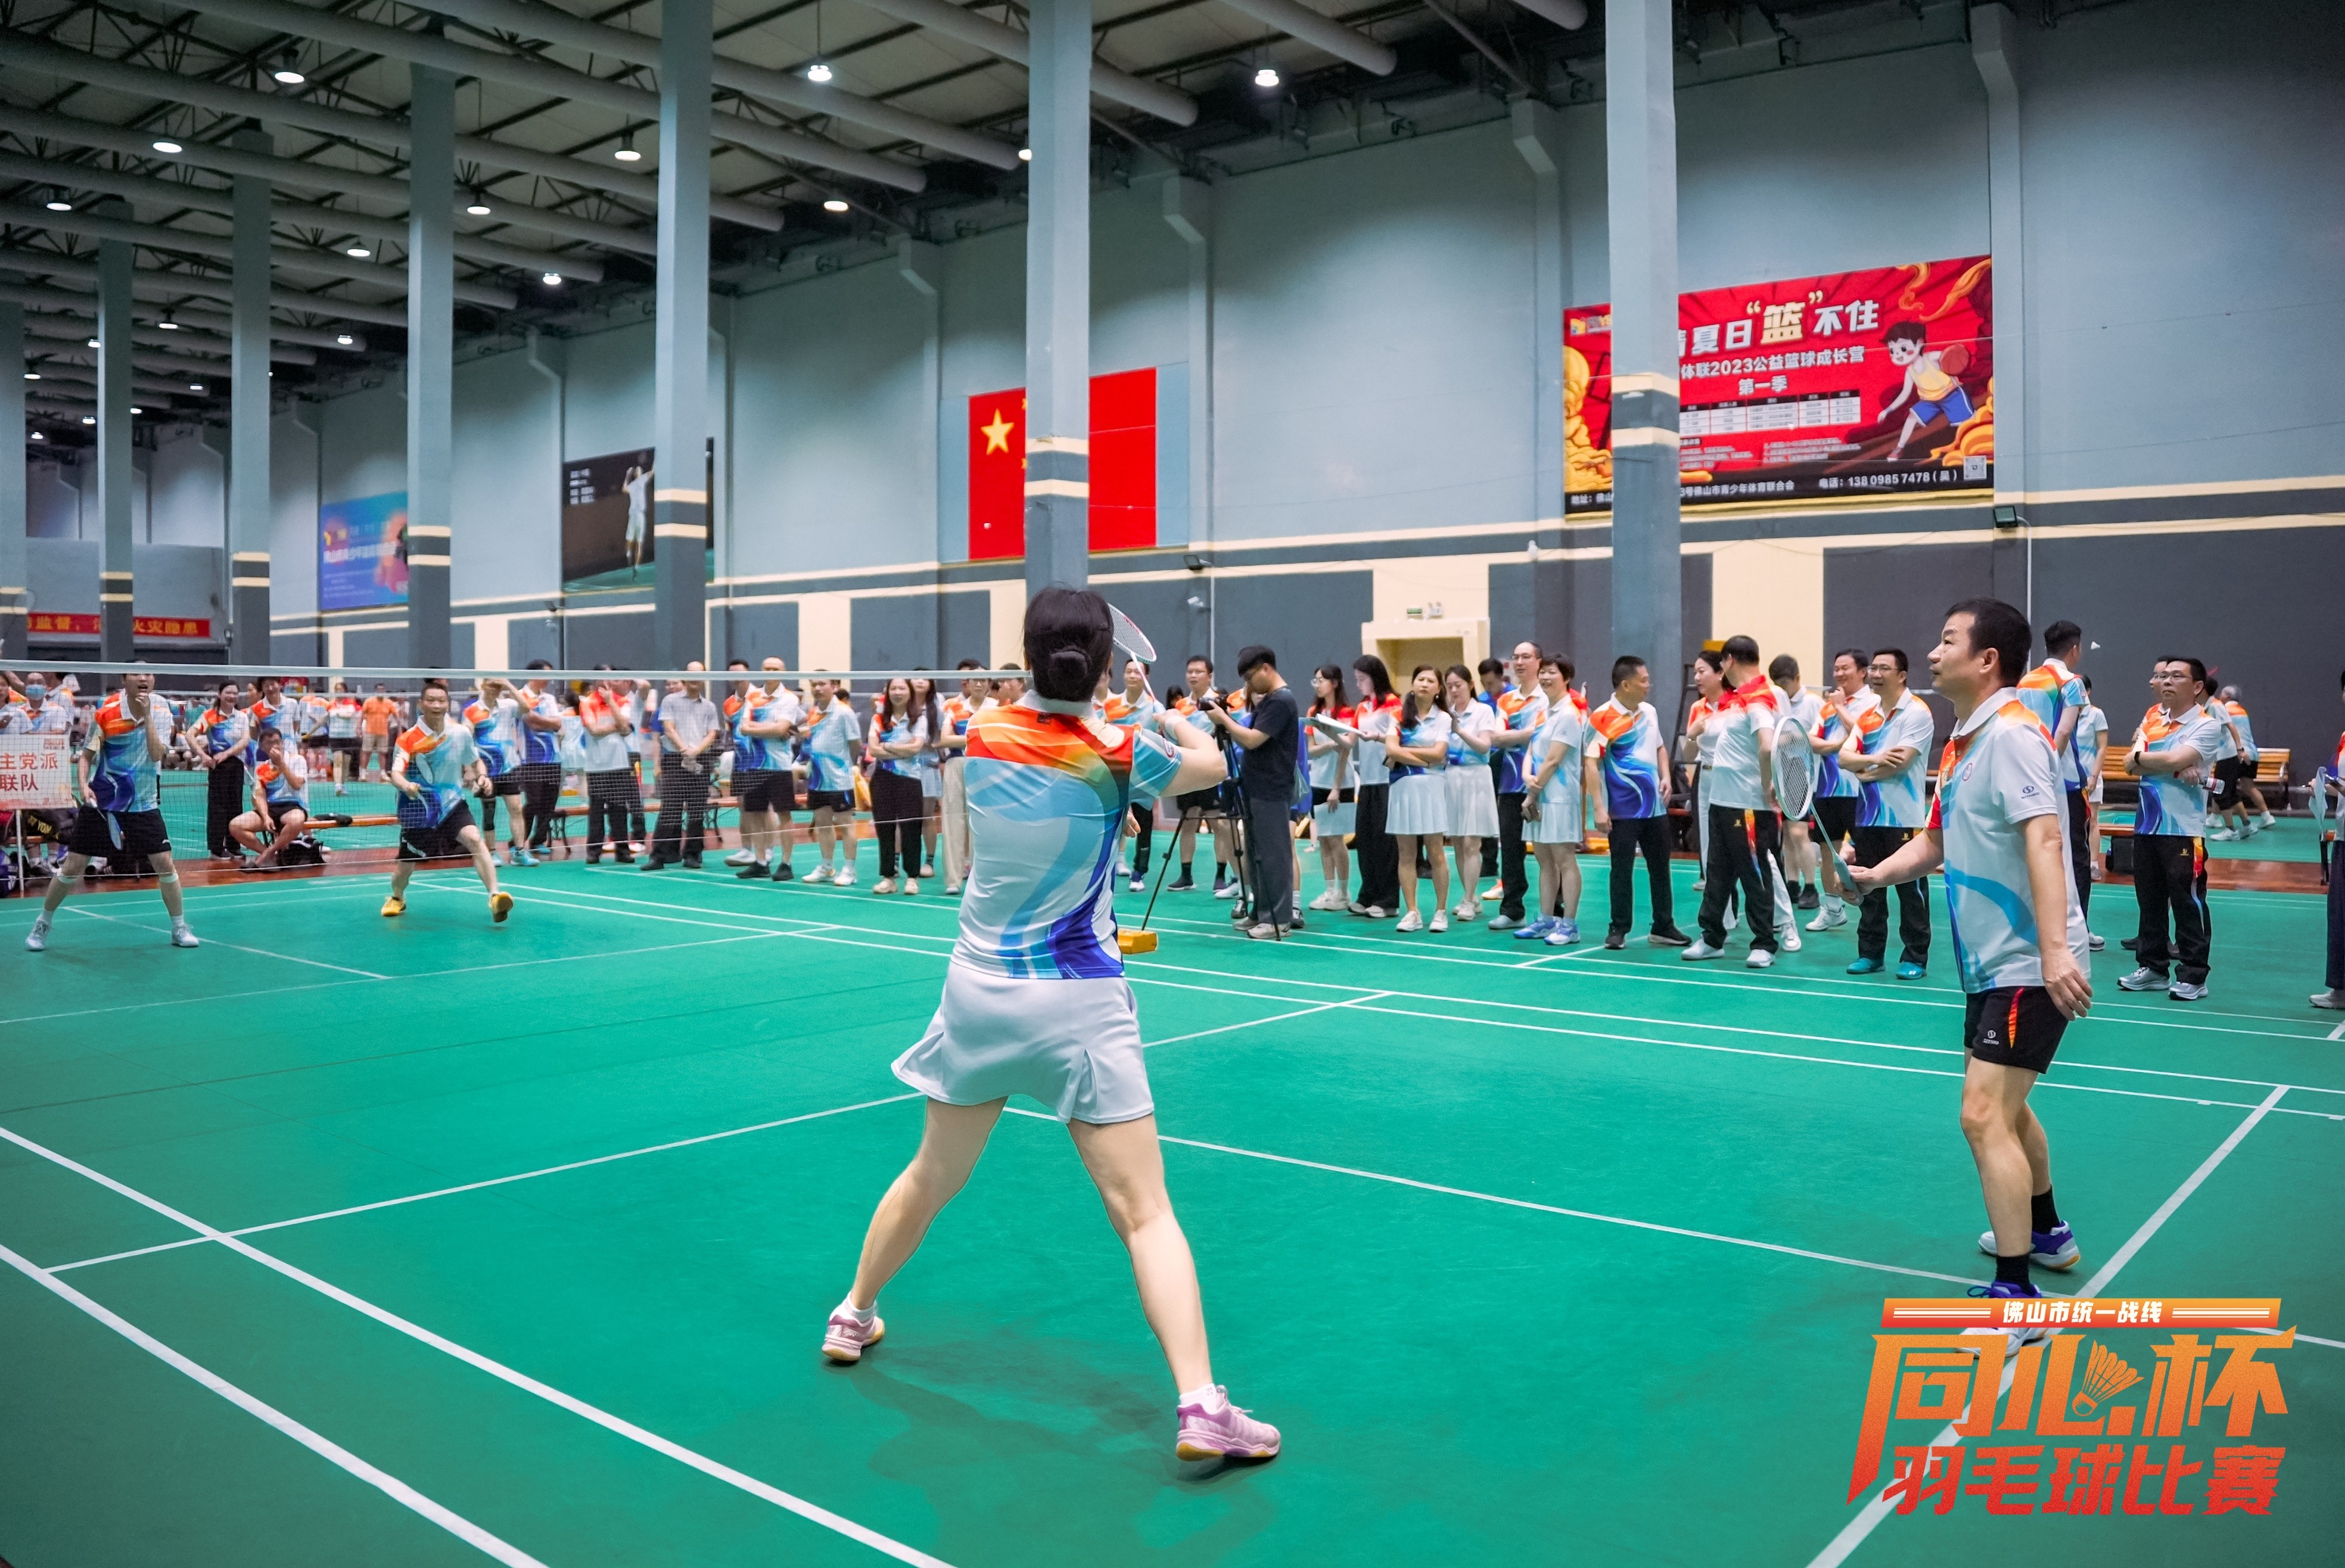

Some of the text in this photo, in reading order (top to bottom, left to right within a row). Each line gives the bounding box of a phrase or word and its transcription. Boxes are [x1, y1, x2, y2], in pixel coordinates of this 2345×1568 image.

[1738, 375, 1787, 396] 第一季
[0, 752, 58, 770] 主党派
[0, 773, 39, 792] 联队
